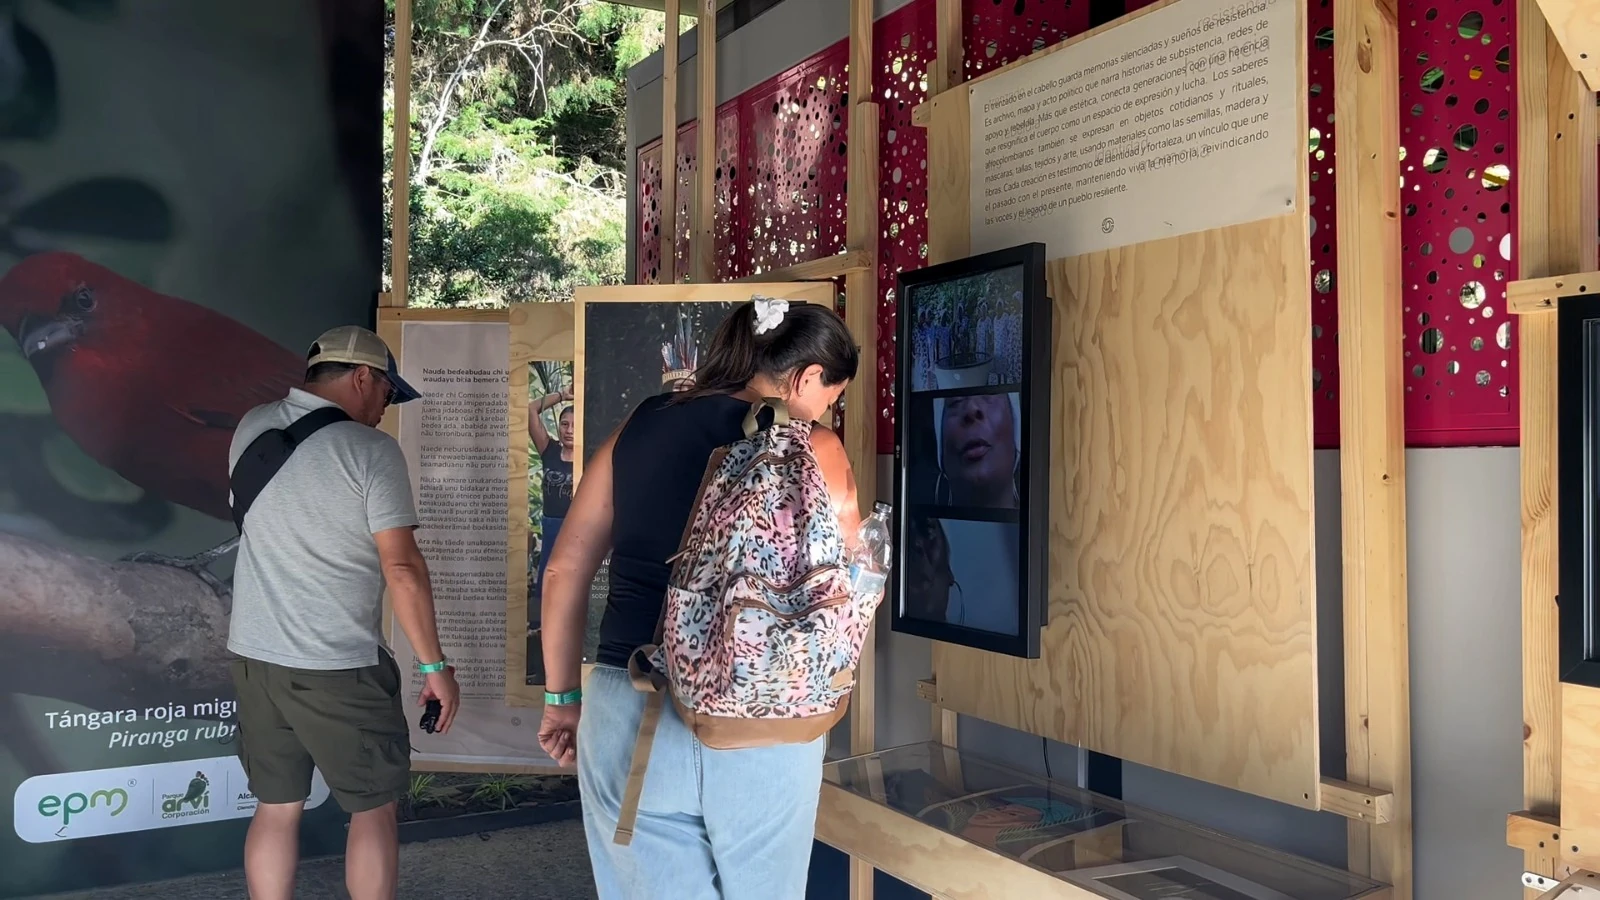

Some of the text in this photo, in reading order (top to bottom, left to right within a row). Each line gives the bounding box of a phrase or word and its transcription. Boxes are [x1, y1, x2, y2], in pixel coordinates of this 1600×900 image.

[985, 117, 992, 127] Es
[1018, 103, 1035, 115] mapa
[1037, 101, 1041, 111] y
[1042, 95, 1057, 106] acto
[1059, 86, 1083, 103] político
[1085, 80, 1099, 94] que
[1101, 73, 1119, 86] narra
[1122, 60, 1154, 78] historias
[1156, 55, 1167, 66] de
[1170, 36, 1224, 62] subsistencia,
[1227, 25, 1253, 42] redes
[1256, 19, 1268, 32] de
[985, 129, 1003, 142] apoyo
[1005, 127, 1008, 137] y
[1039, 111, 1052, 123] Más
[1055, 107, 1067, 120] que
[1070, 97, 1099, 112] estética,
[1101, 85, 1130, 102] conecta
[1133, 66, 1186, 94] generaciones
[1190, 59, 1205, 72] con
[1209, 52, 1225, 65] una
[1229, 37, 1268, 59] herencia
[1018, 92, 1026, 101] en
[1027, 87, 1033, 97] el
[1034, 79, 1057, 95] cabello
[1059, 70, 1082, 88] guarda
[1084, 57, 1119, 76] memorias
[1120, 40, 1162, 63] silenciadas
[1164, 38, 1169, 50] y
[1171, 26, 1201, 44] sueños
[1203, 21, 1214, 33] de
[1217, 2, 1268, 28] resistencia.
[985, 145, 996, 157] que
[1030, 130, 1035, 140] el
[1037, 124, 1059, 138] cuerpo
[1061, 118, 1080, 130] como
[1082, 114, 1091, 123] un
[1093, 103, 1121, 120] espacio
[1123, 100, 1133, 110] de
[1135, 86, 1173, 106] expresión
[1175, 85, 1180, 97] y
[1183, 76, 1207, 91] lucha.
[1213, 69, 1229, 82] Los
[1232, 56, 1268, 76] saberes
[1035, 156, 1056, 170] tejidos
[1058, 155, 1062, 165] y
[1063, 150, 1078, 161] arte,
[1080, 140, 1106, 156] usando
[1108, 130, 1146, 148] materiales
[1148, 122, 1170, 136] como
[1173, 118, 1184, 129] las
[1186, 108, 1223, 125] semillas,
[1226, 96, 1260, 113] madera
[1262, 93, 1269, 106] y
[1039, 137, 1064, 152] también
[1070, 134, 1077, 143] se
[1083, 123, 1114, 139] expresan
[1120, 118, 1129, 128] en
[1135, 107, 1164, 123] objetos
[1170, 92, 1214, 112] cotidianos
[1220, 88, 1226, 100] y
[1232, 75, 1268, 93] rituales,
[985, 129, 1269, 212] el pasado con el presente, manteniendo viva la memoria, reivindicando
[1004, 181, 1019, 192] Cada
[1021, 173, 1047, 188] creación
[1048, 171, 1056, 180] es
[1057, 160, 1093, 177] testimonio
[1094, 157, 1103, 167] de
[1105, 146, 1139, 164] identidad
[1141, 146, 1146, 157] y
[1147, 136, 1184, 153] fortaleza,
[1186, 132, 1196, 142] un
[1198, 122, 1229, 138] vínculo
[1231, 117, 1249, 132] que
[1251, 111, 1269, 124] une
[985, 218, 994, 226] las
[996, 213, 1013, 223] voces
[1014, 212, 1017, 221] y
[1019, 208, 1024, 218] el
[1048, 201, 1057, 210] de
[1059, 199, 1067, 208] un
[1068, 192, 1092, 208] pueblo
[1094, 184, 1128, 199] resiliente.
[44, 708, 136, 730] Tángara
[144, 702, 186, 723] roja
[108, 728, 189, 748] Piranga
[38, 788, 128, 825] epm
[162, 808, 210, 819] Corporación
